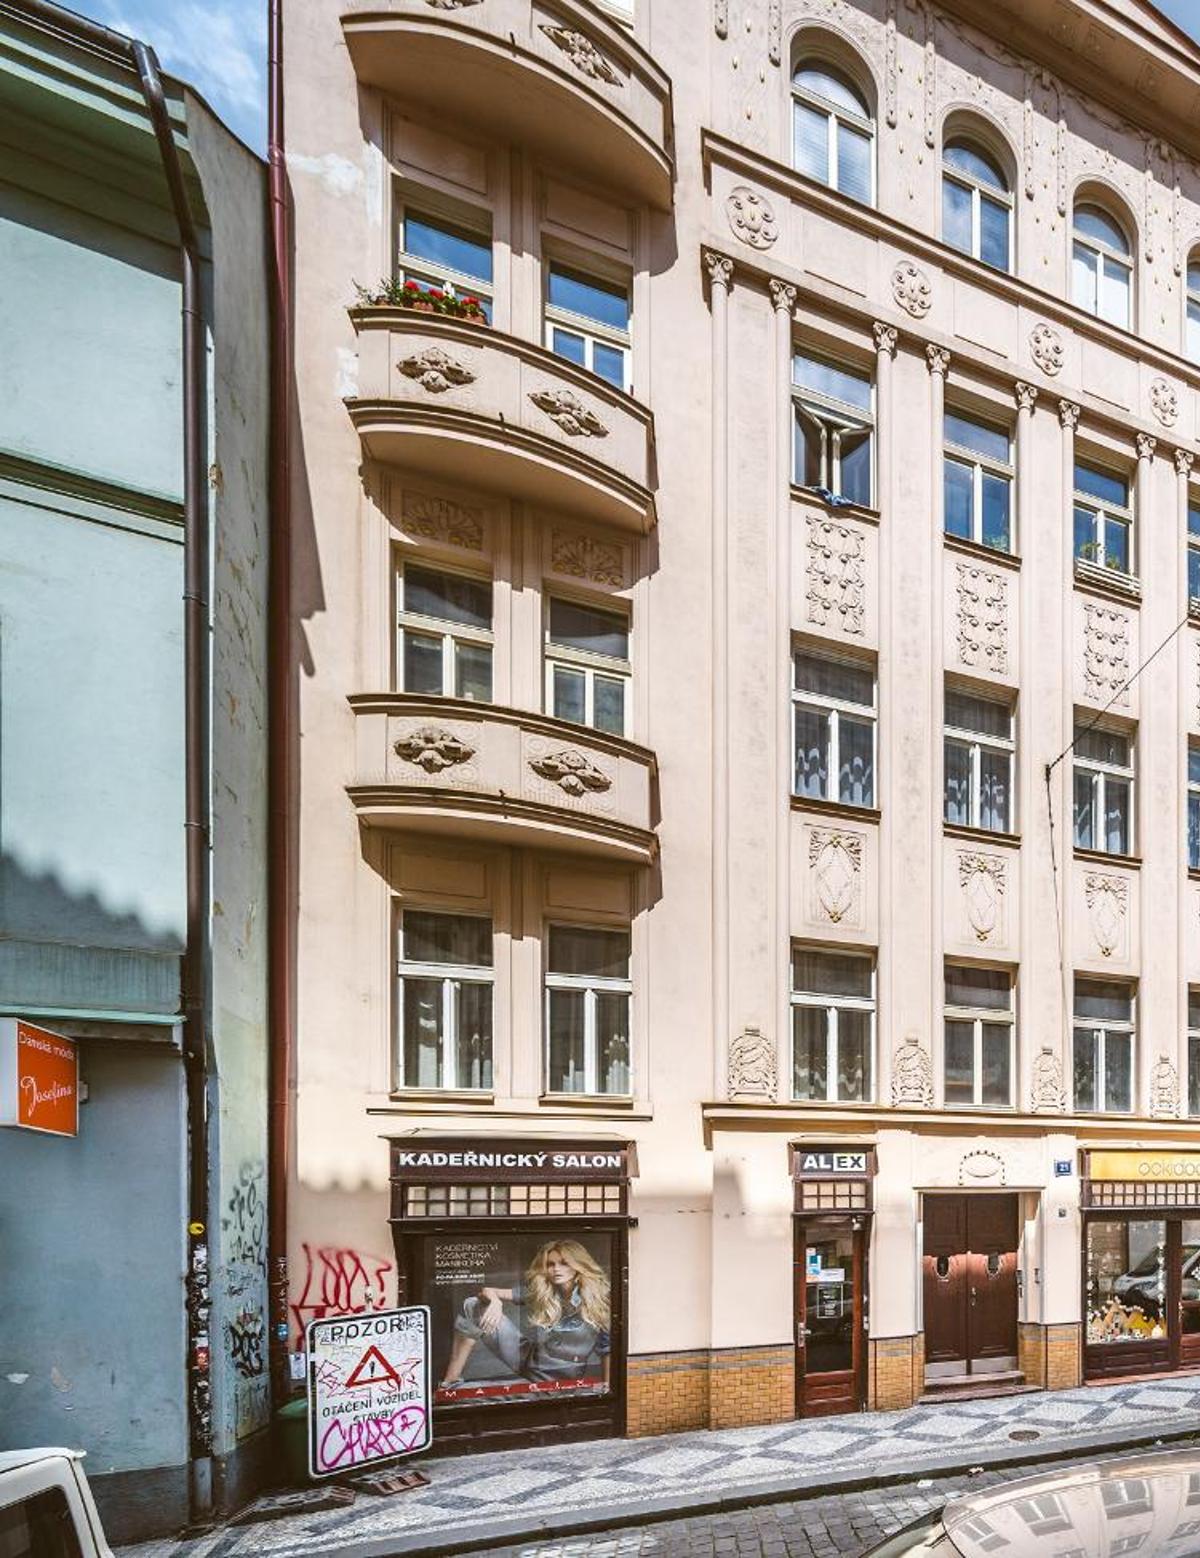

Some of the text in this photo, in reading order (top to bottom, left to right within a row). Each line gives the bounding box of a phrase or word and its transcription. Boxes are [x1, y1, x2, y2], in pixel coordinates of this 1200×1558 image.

[20, 1075, 73, 1118] Josefina
[400, 1151, 621, 1168] KADEŘNICKÝ SALON
[803, 1154, 863, 1170] ALEX
